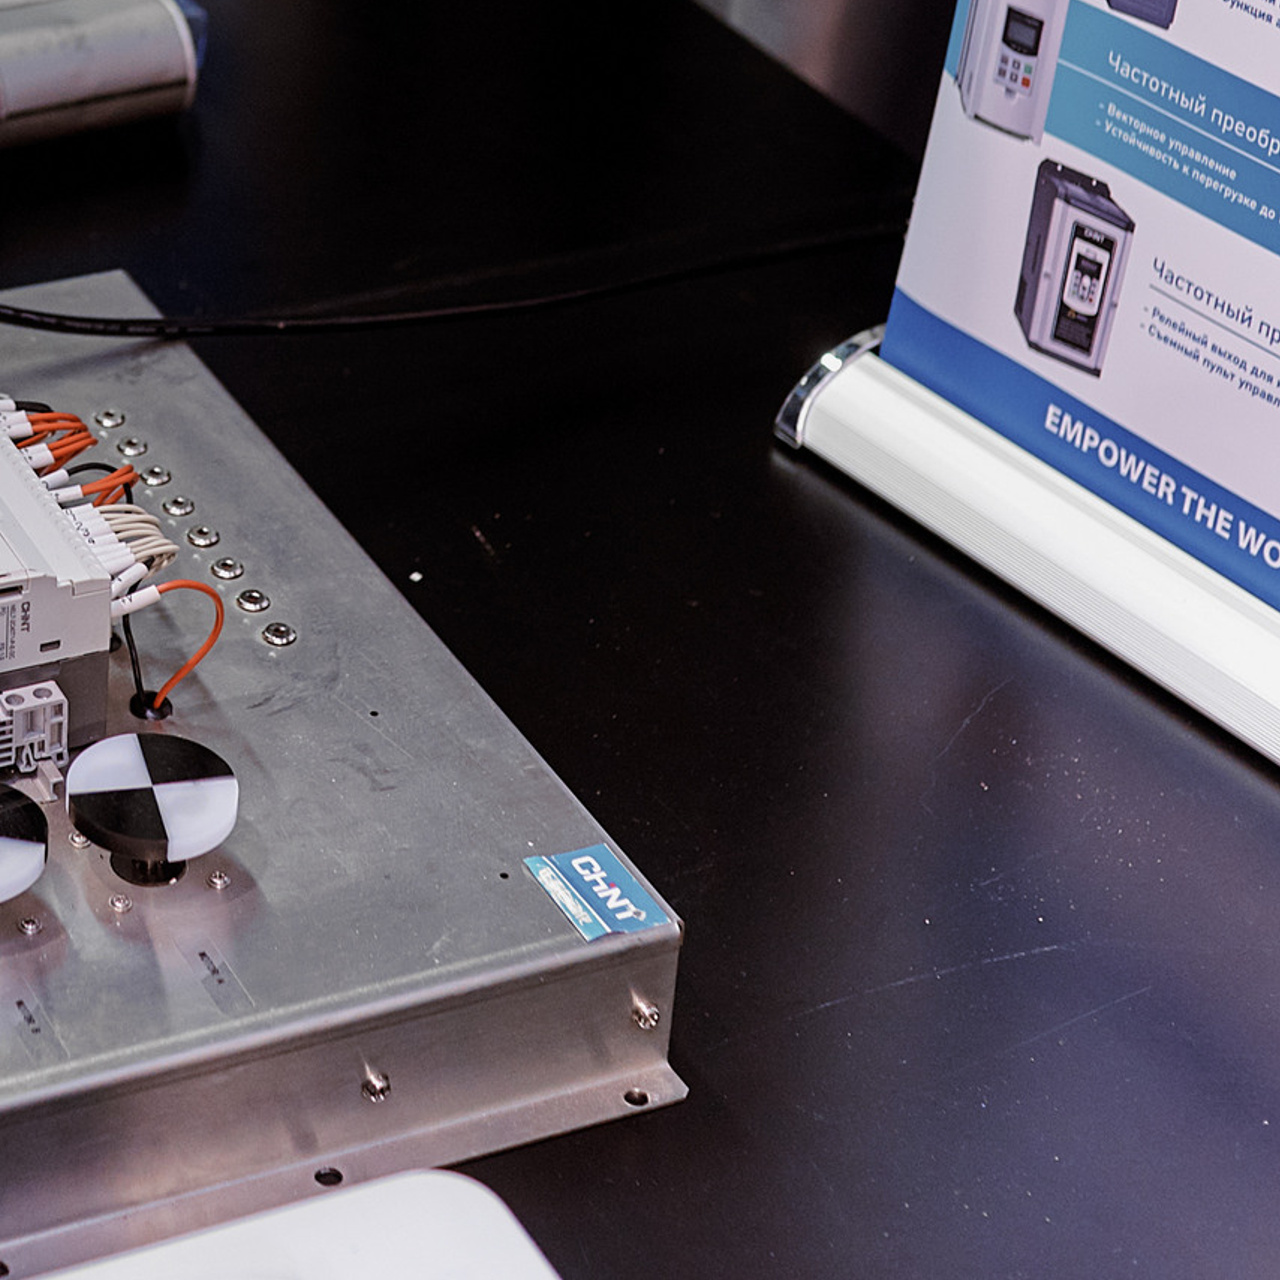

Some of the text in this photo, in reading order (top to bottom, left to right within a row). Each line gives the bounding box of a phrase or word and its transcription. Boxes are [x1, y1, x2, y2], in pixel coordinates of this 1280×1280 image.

[1109, 50, 1207, 118] Частотный
[1104, 119, 1180, 170] Устойчивость
[1191, 168, 1257, 210] перегрузке
[1259, 205, 1275, 220] до
[1107, 102, 1237, 180] Векторное управление
[1153, 257, 1253, 328] Частотный
[1148, 324, 1200, 362] Съемный
[1202, 358, 1235, 382] пульт
[1151, 307, 1274, 383] Релейный выход для
[1044, 403, 1280, 569] EMPOWER THE WO
[20, 601, 31, 632] CHINT
[571, 855, 646, 922] CHINT
